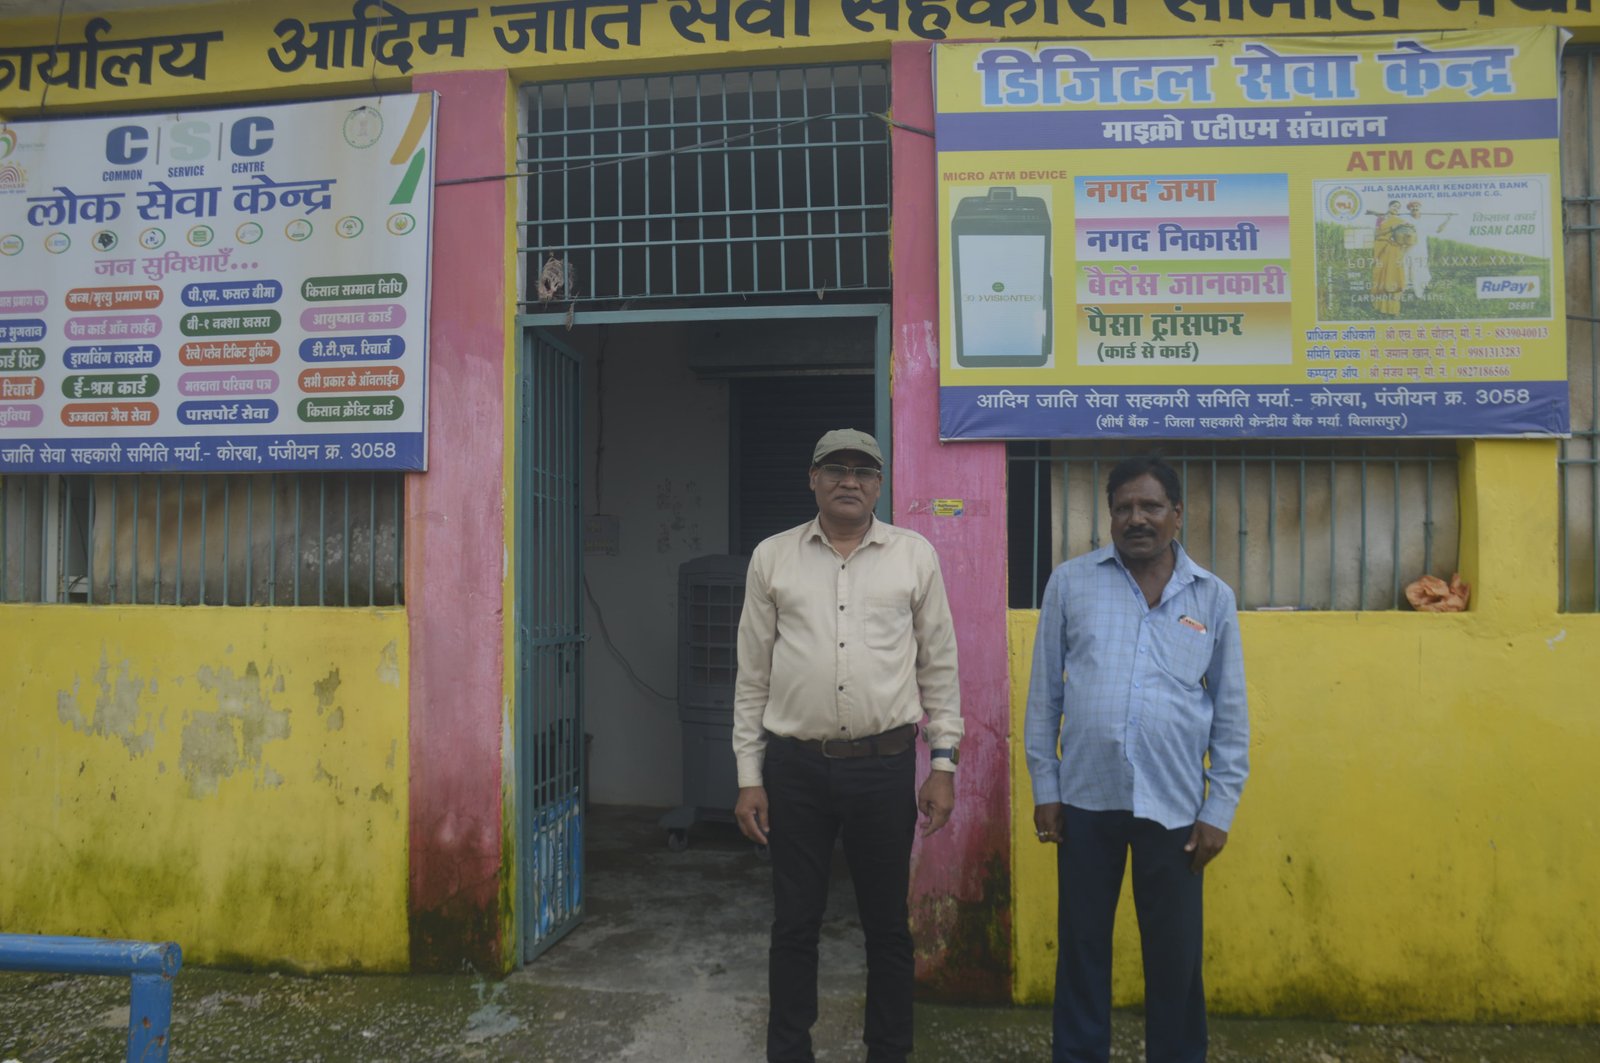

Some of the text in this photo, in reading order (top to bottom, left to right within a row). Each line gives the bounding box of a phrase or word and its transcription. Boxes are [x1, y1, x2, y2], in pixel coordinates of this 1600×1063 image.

[268, 0, 478, 74] आदिम
[667, 0, 810, 43] सवा
[977, 41, 1515, 106] डिजिटल सेवा केन्द्र
[1102, 111, 1387, 145] माइक्रो एटीएम संचालन
[1346, 147, 1514, 171] ATM CARD
[102, 161, 265, 182] COMMON SERVICE CENTRE
[943, 170, 1067, 182] MICRO ATM DEVICE
[1086, 179, 1218, 203] नगद जमा
[1361, 181, 1528, 193] JILA SAHAKARI KENDRIYA BANK
[27, 174, 337, 227] लोक सेवा केन्द्र
[1086, 222, 1260, 252] नगद निकासी
[1469, 224, 1536, 236] KISAN CARD
[95, 258, 136, 277] जन
[305, 278, 403, 297] किसान सम्मान निधि
[1084, 265, 1287, 296] बैलेंस जानकारी
[1481, 280, 1527, 294] RuPay
[114, 290, 143, 302] प्रमाण
[145, 289, 160, 301] पत्र
[222, 288, 250, 300] फसल
[252, 283, 276, 299] बीमा
[71, 322, 85, 336] पैन
[87, 320, 106, 335] कार्ड
[130, 318, 156, 333] लाईन
[213, 317, 241, 329] नक्शा
[242, 316, 272, 328] खसरा
[312, 307, 393, 328] आयुष्मान कार्ड
[1084, 305, 1245, 342] पैसा ट्रांसफर
[9, 326, 43, 343] भुगतान
[360, 339, 392, 355] रिचार्ज
[1097, 341, 1200, 363] (कार्ड से कार्ड)
[18, 347, 40, 369] प्रिंट
[3, 374, 37, 396] रिचार्ज
[73, 374, 148, 398] ई-श्रम कार्ड
[185, 379, 220, 392] मतदाता
[256, 377, 273, 391] पत्र
[303, 375, 322, 388] सभी
[976, 391, 1029, 409] आदिम
[1036, 390, 1078, 408] जाति
[1085, 388, 1119, 409] सेवा
[1126, 389, 1190, 409] सहकारी
[1197, 388, 1251, 408] समिति
[1311, 386, 1368, 408] कोरबा,
[1374, 386, 1437, 406] पंजीयन
[1475, 388, 1530, 405] 3058
[111, 407, 129, 423] गैस
[130, 406, 152, 421] सेवा
[185, 403, 269, 421] पासपोर्ट सेवा
[306, 402, 341, 418] किसान
[372, 399, 395, 416] कार्ड
[1128, 413, 1150, 428] बैंक
[1164, 414, 1195, 429] जिला
[1201, 413, 1245, 429] सहकारी
[1248, 413, 1288, 430] केन्द्रीय
[1292, 413, 1312, 427] बैंक
[1348, 412, 1408, 430] बिलासपुर)
[2, 444, 35, 464] जाति
[40, 443, 66, 463] सेवा
[71, 442, 122, 464] सहकारी
[127, 442, 170, 463] समिति
[217, 440, 262, 464] कोरबा,
[268, 440, 319, 461] पंजीयन
[351, 442, 396, 458] 3058
